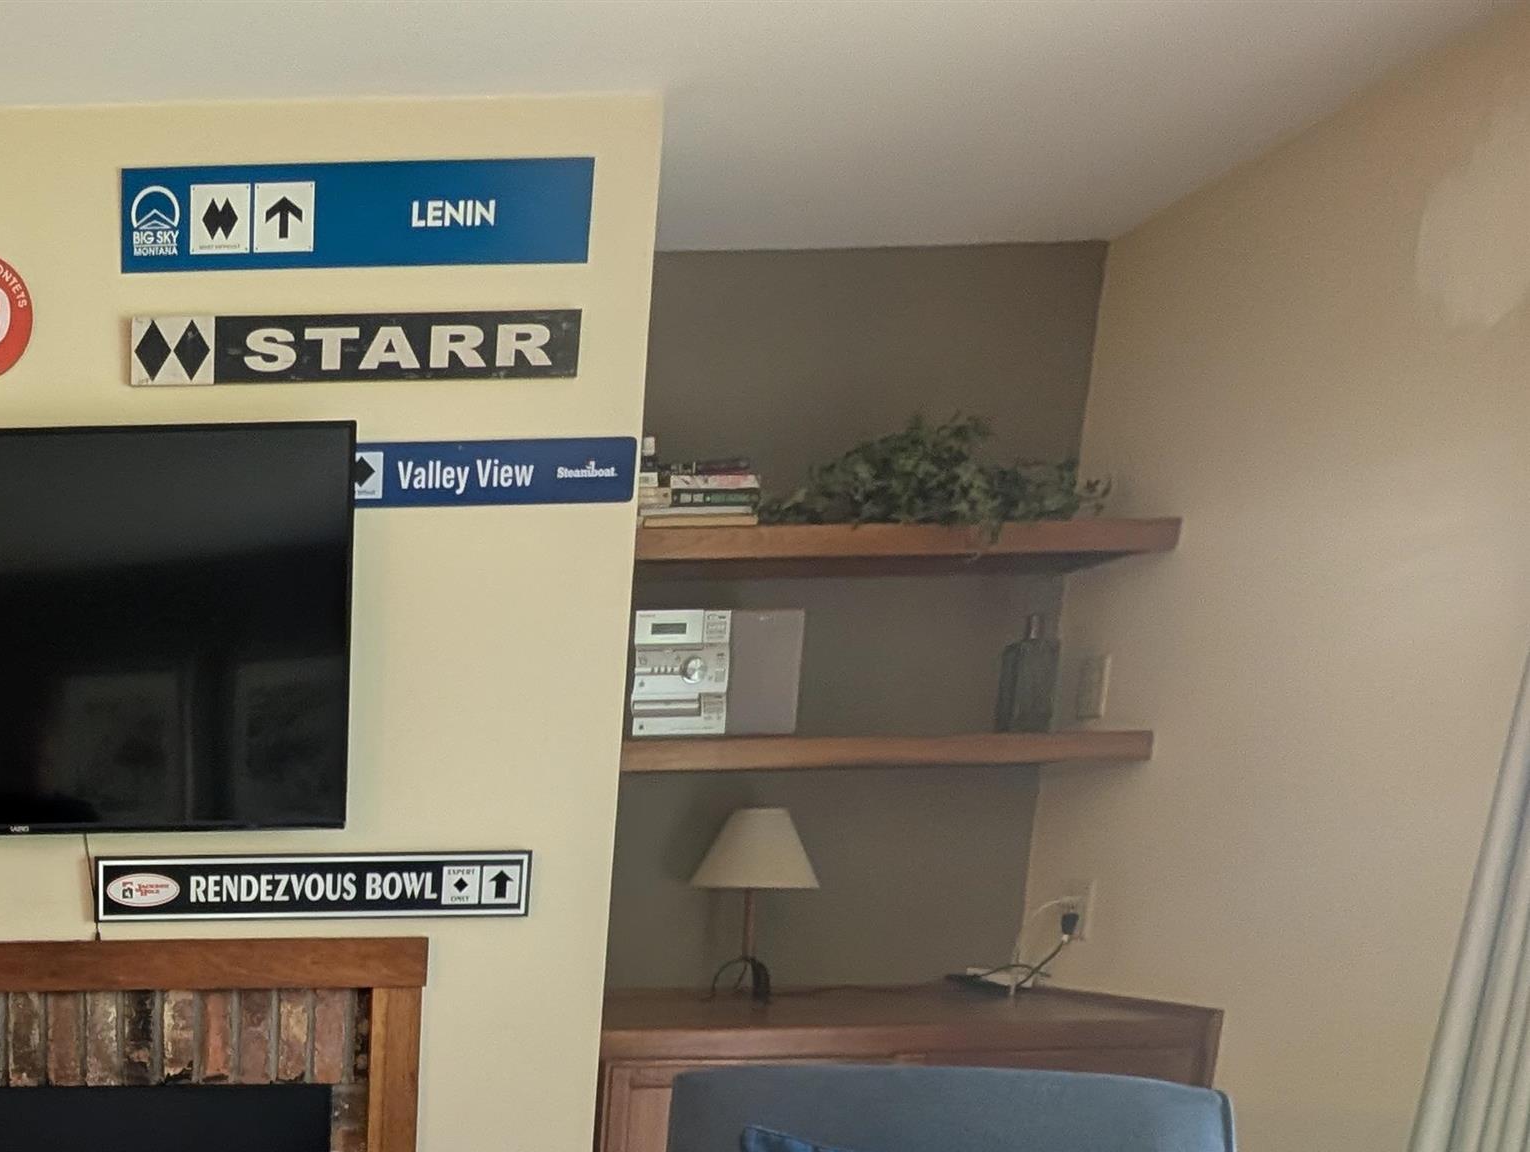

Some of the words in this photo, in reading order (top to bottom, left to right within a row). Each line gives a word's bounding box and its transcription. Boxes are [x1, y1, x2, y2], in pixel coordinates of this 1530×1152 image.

[411, 200, 496, 227] LENIN
[133, 231, 155, 244] BIG
[156, 230, 179, 243] SKY
[133, 246, 178, 256] MONTANA
[243, 324, 553, 372] STARR
[397, 460, 470, 495] Valley
[476, 458, 535, 488] View
[556, 460, 618, 479] Steamboat
[447, 868, 475, 876] EXPERT
[189, 872, 357, 904] RENDEZVOUS
[365, 871, 438, 900] BOWL
[450, 895, 470, 903] ONLY
